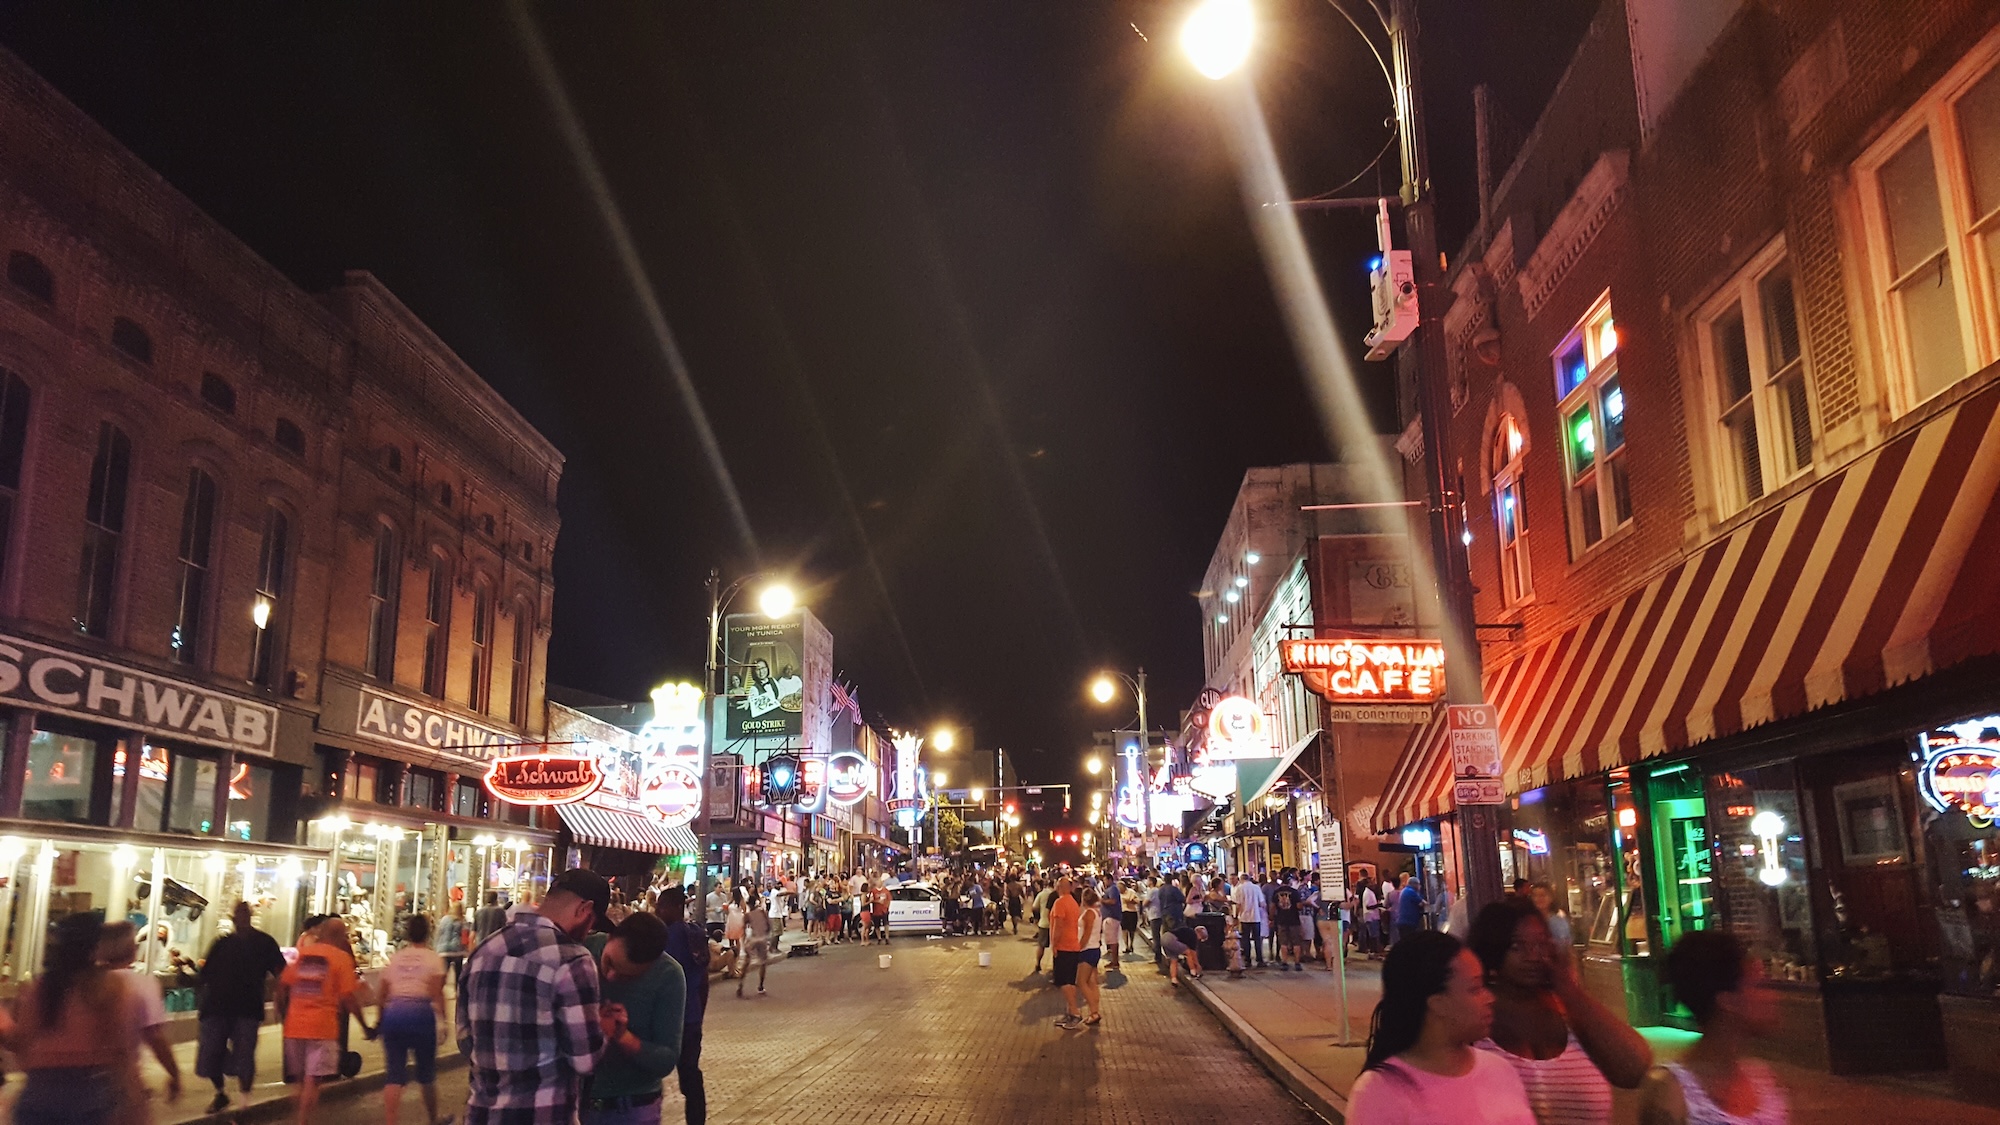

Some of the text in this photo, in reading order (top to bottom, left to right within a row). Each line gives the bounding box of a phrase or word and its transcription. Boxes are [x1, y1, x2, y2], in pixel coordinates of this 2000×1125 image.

[1373, 645, 1444, 668] PALA
[741, 719, 786, 730] GOLD STRIKE
[1457, 709, 1487, 726] NO
[1454, 731, 1492, 741] PARKING
[1455, 745, 1496, 755] STANDING
[515, 761, 594, 784] Schwab
[1519, 768, 1532, 784] 162
